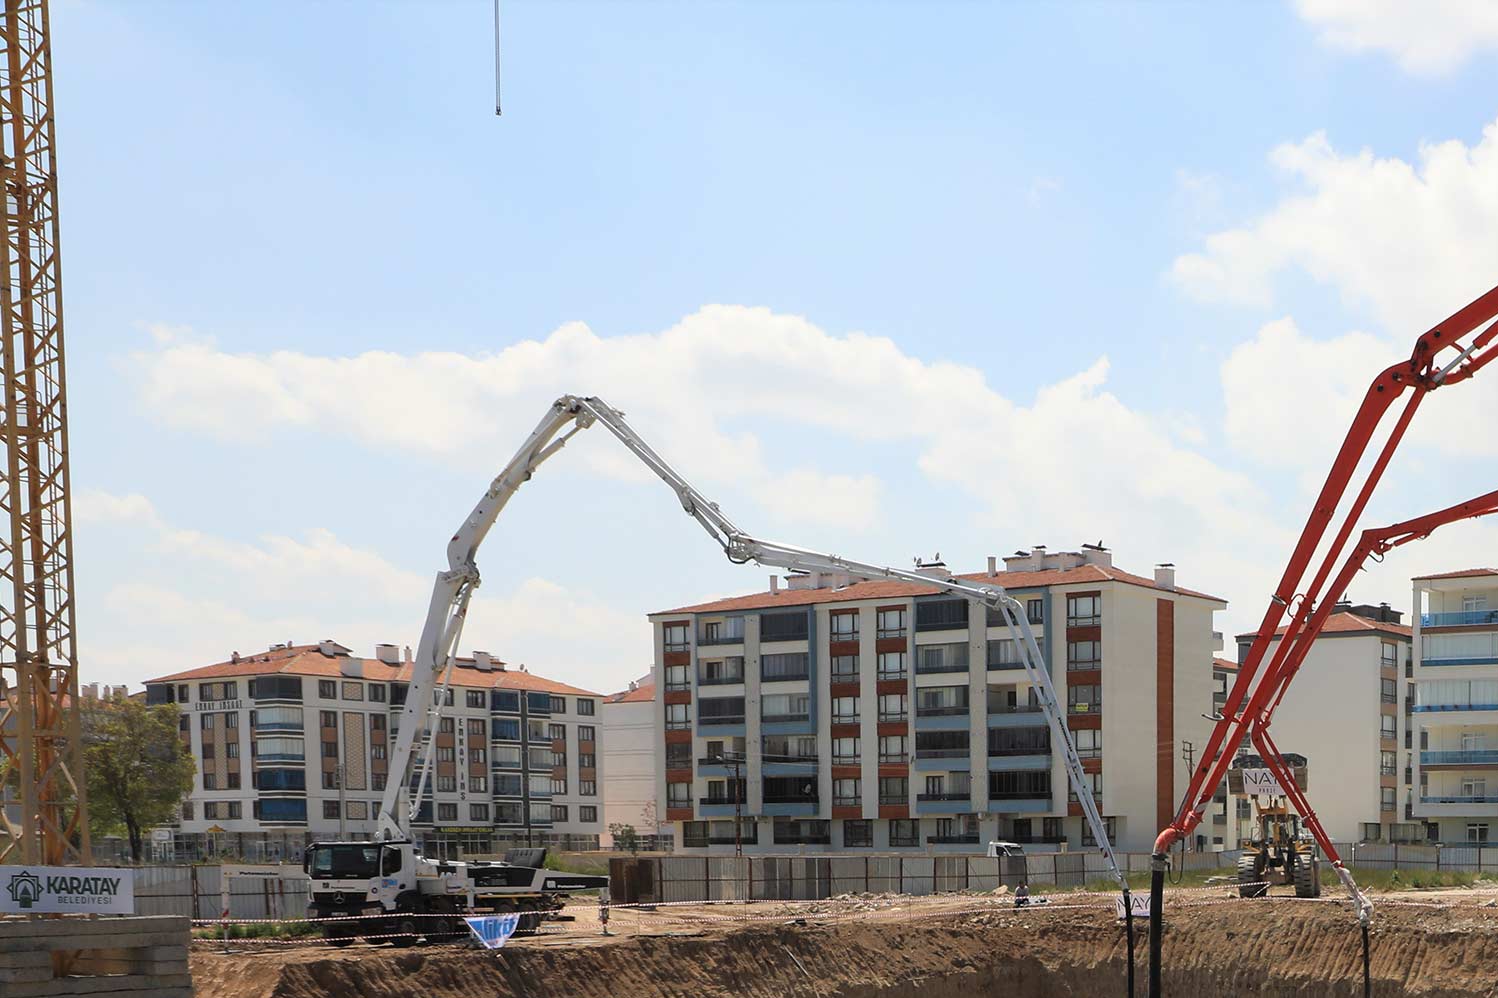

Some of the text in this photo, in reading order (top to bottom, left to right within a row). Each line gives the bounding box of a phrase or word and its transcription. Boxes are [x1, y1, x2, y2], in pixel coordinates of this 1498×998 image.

[1244, 771, 1289, 785] NAY
[47, 876, 121, 896] KARATAY
[1117, 896, 1151, 911] NAY
